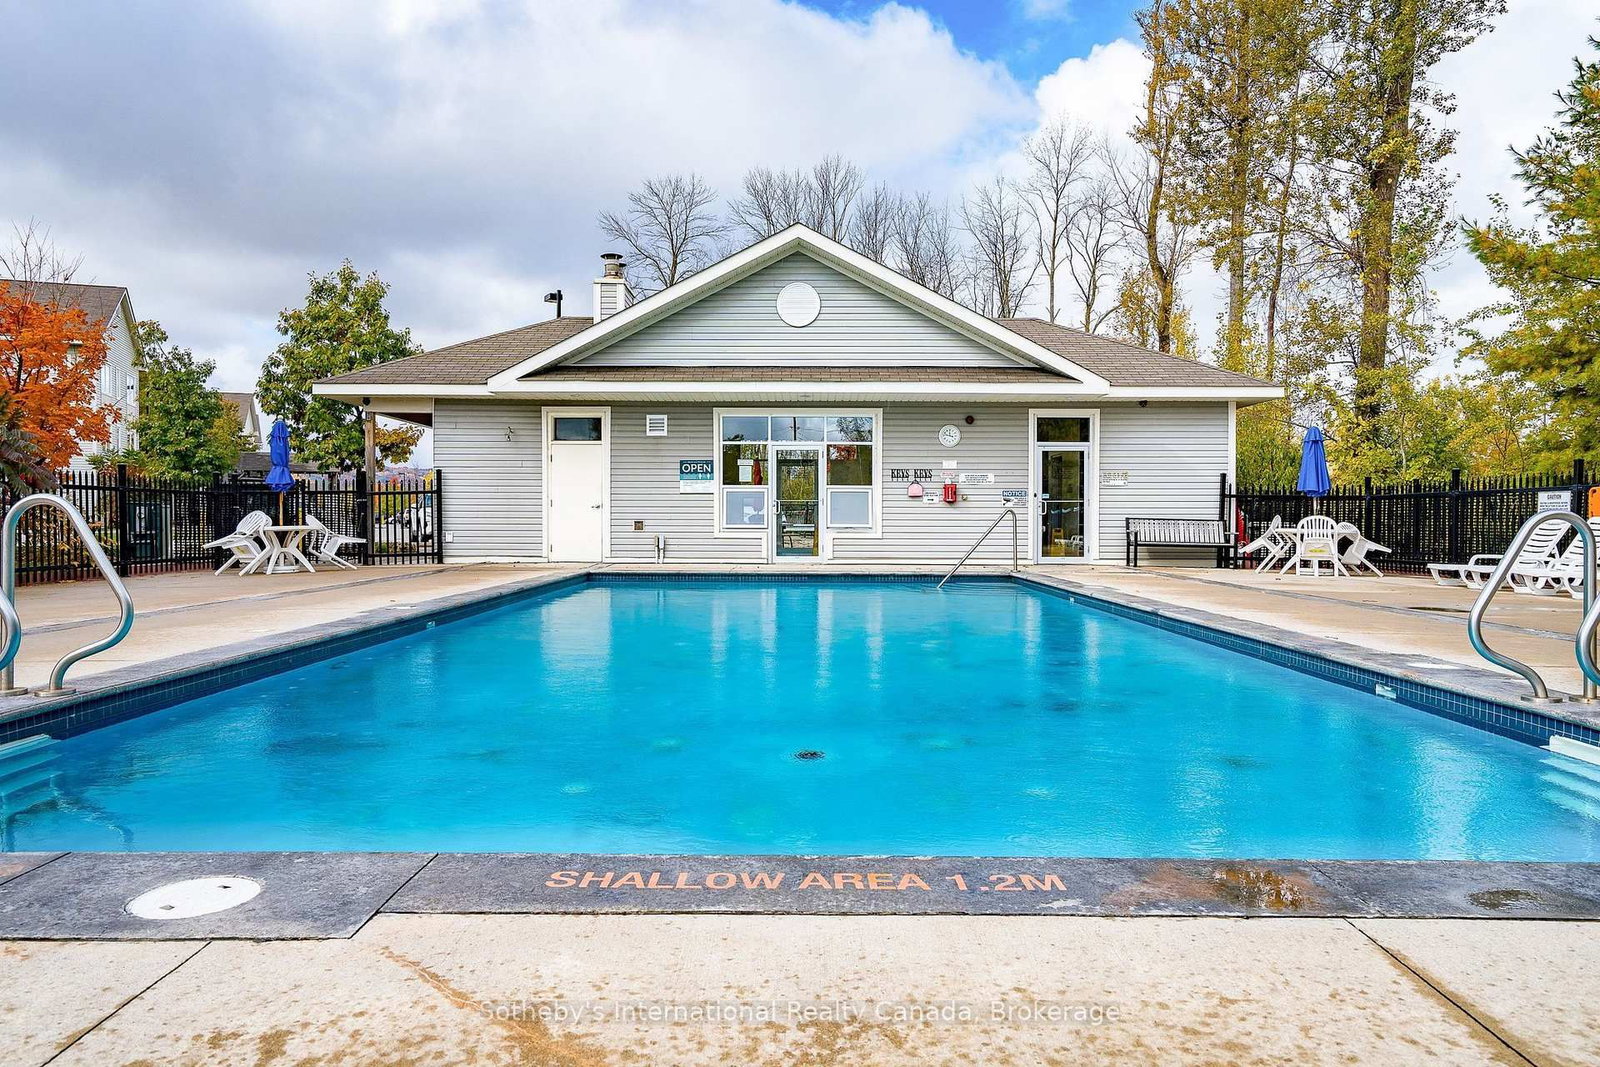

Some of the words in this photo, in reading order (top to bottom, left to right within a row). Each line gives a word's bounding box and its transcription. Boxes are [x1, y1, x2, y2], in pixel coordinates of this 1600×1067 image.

[682, 463, 711, 472] OPEN
[891, 469, 910, 479] KEYS
[914, 469, 933, 479] KEYS
[545, 870, 786, 890] SHALLOW
[798, 872, 932, 891] AREA
[945, 874, 1068, 892] 1.2M
